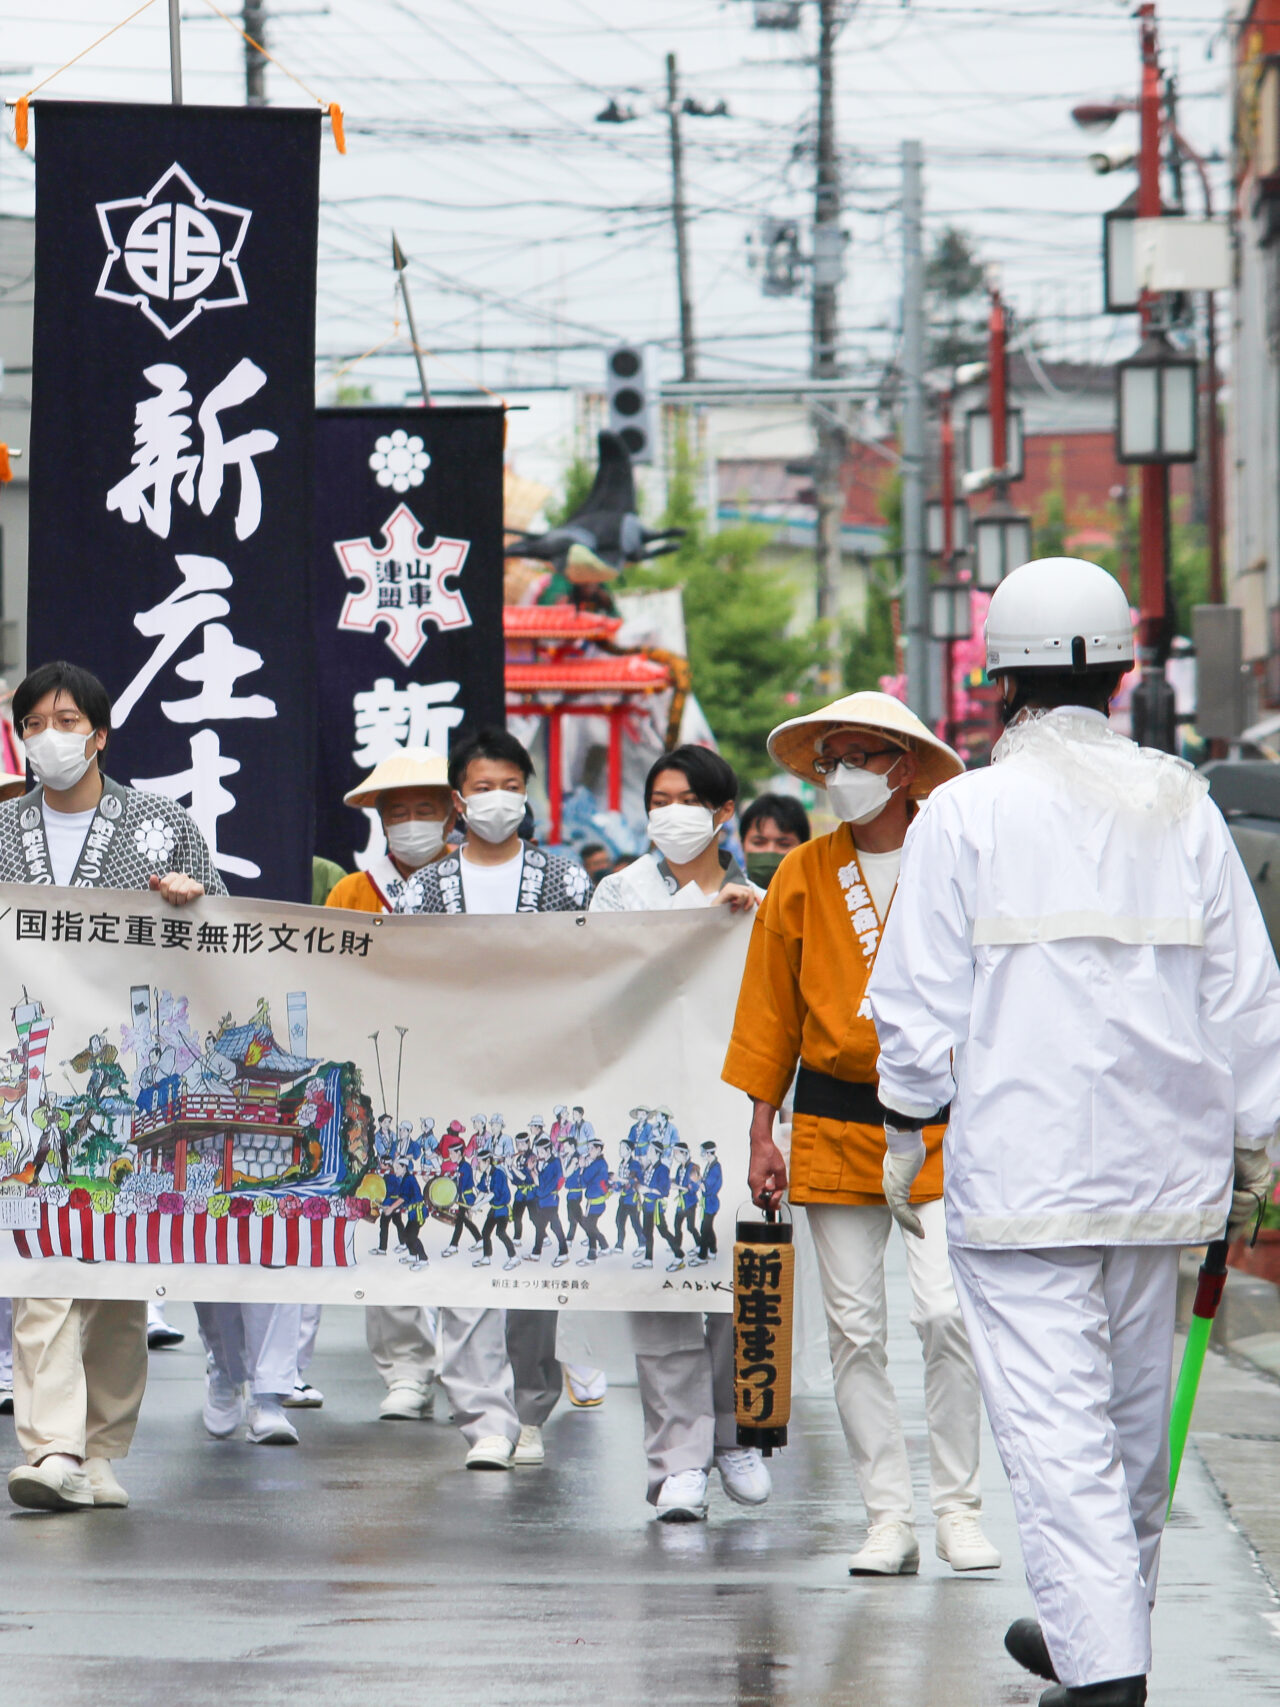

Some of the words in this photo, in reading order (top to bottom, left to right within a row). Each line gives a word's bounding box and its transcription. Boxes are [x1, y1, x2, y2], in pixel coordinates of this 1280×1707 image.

[491, 1279, 590, 1290] 新庄まつり実行委員会
[737, 1248, 782, 1422] 新庄まつり
